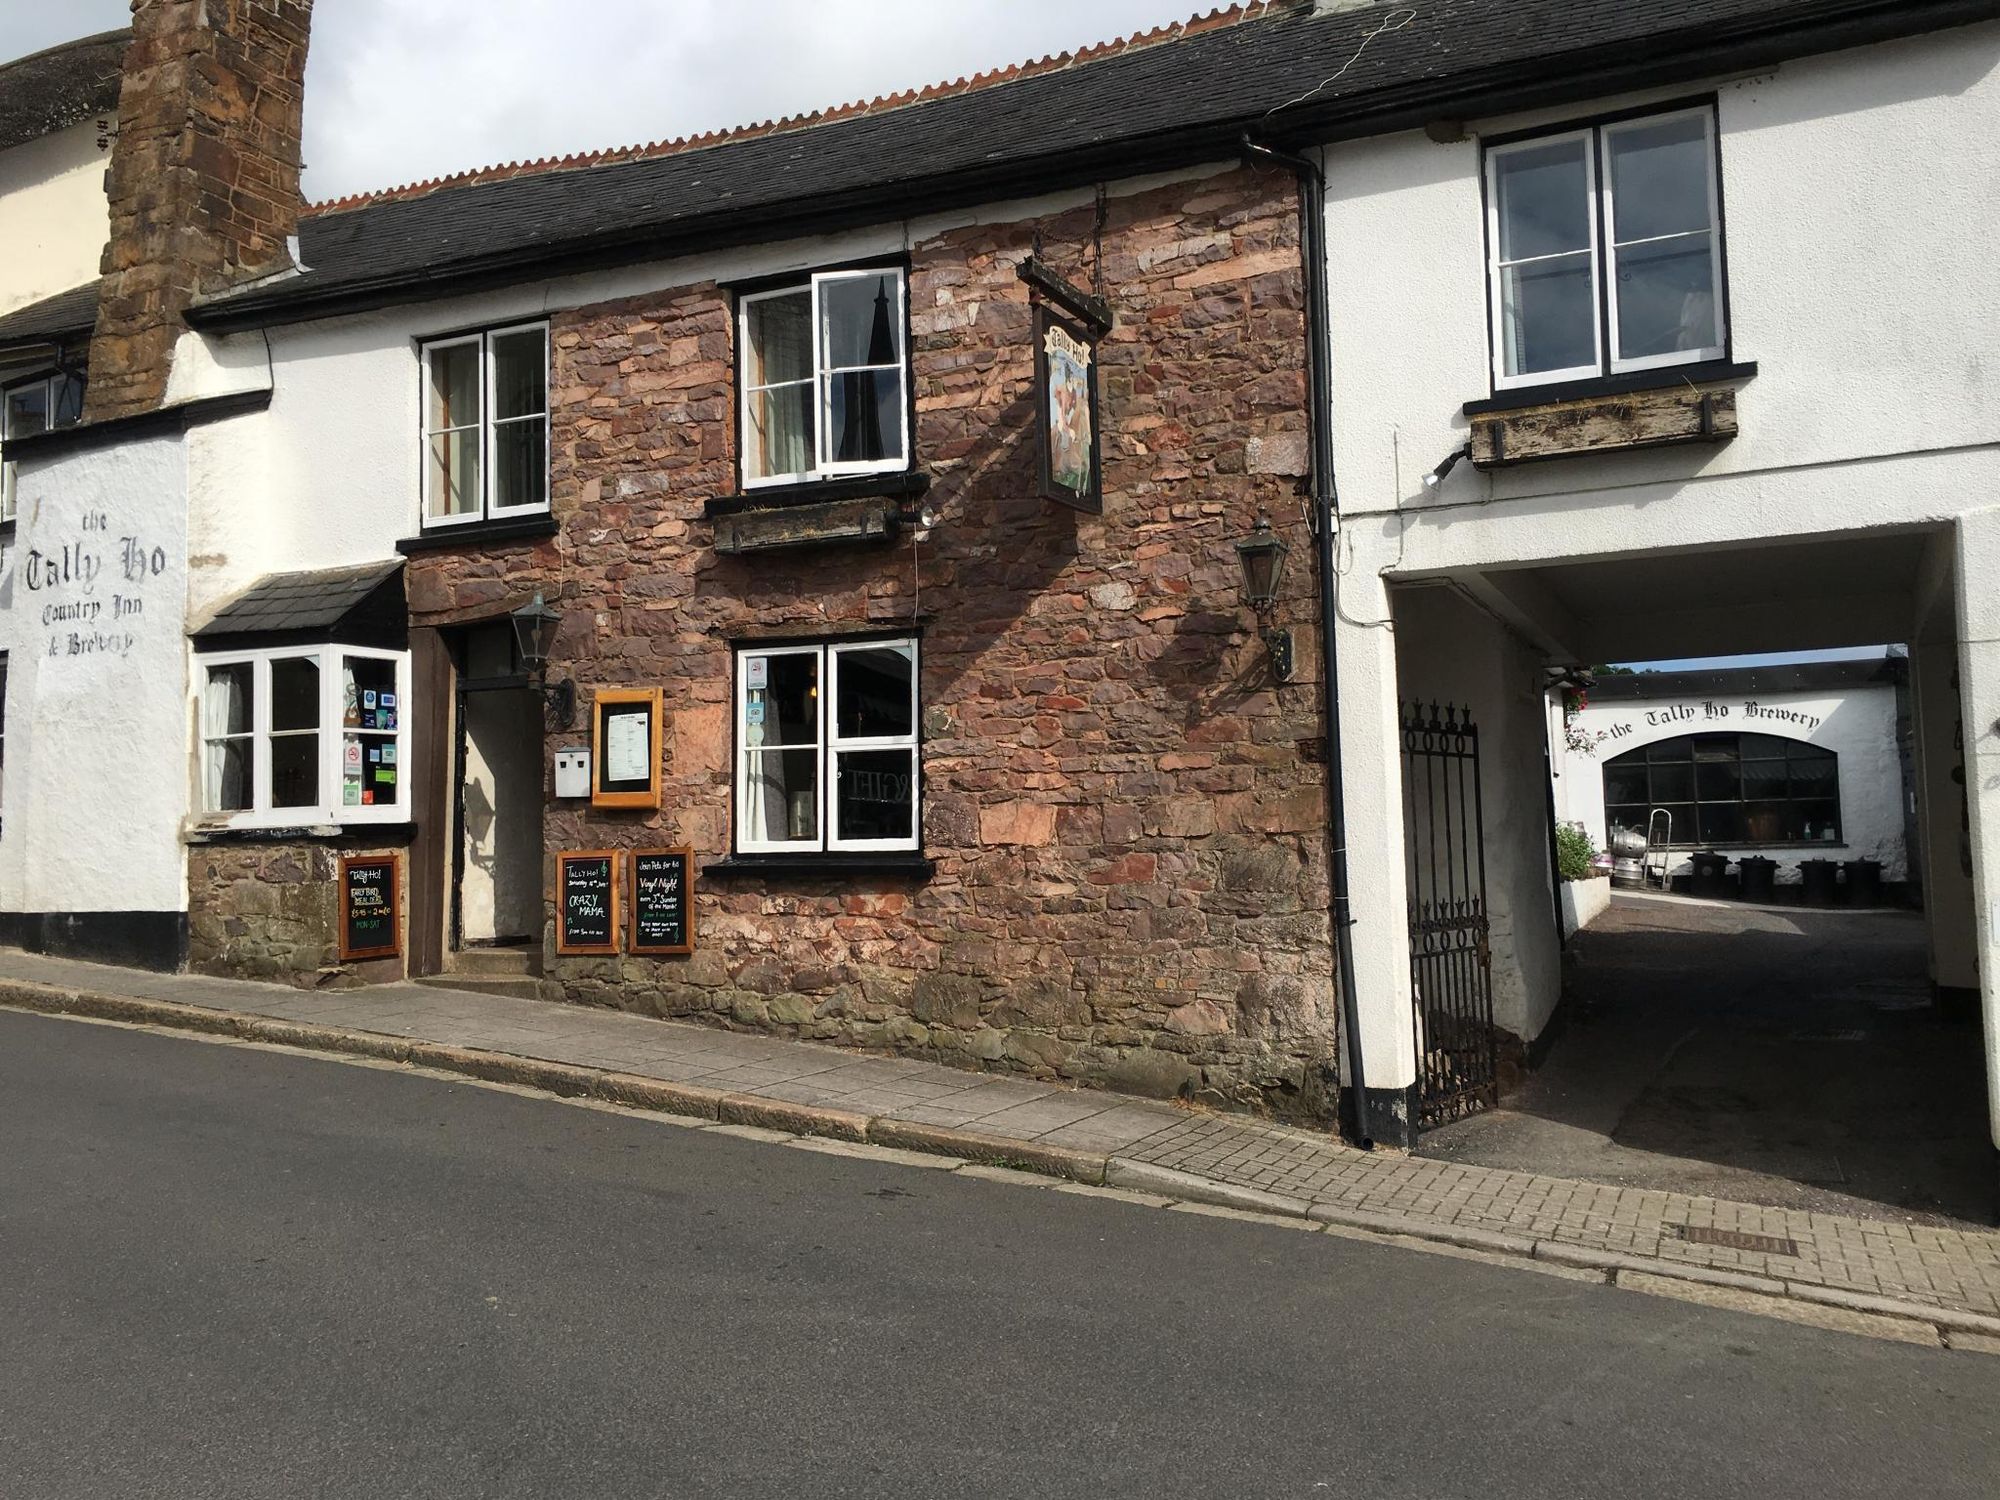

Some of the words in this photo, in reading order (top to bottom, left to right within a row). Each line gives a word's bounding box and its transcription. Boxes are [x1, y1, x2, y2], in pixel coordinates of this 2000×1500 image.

[1051, 328, 1071, 353] Tally
[82, 509, 108, 532] the
[25, 541, 101, 595] Tally
[119, 536, 167, 586] Ho
[42, 600, 101, 626] Country
[112, 594, 143, 620] Inn
[1609, 720, 1633, 740] the
[1643, 703, 1696, 728] Tally
[1700, 700, 1729, 721] Ho
[1742, 700, 1821, 733] Brewery
[566, 865, 586, 878] TALLY
[658, 877, 678, 894] Night
[569, 894, 599, 908] CRAZY
[578, 906, 606, 918] MAMA
